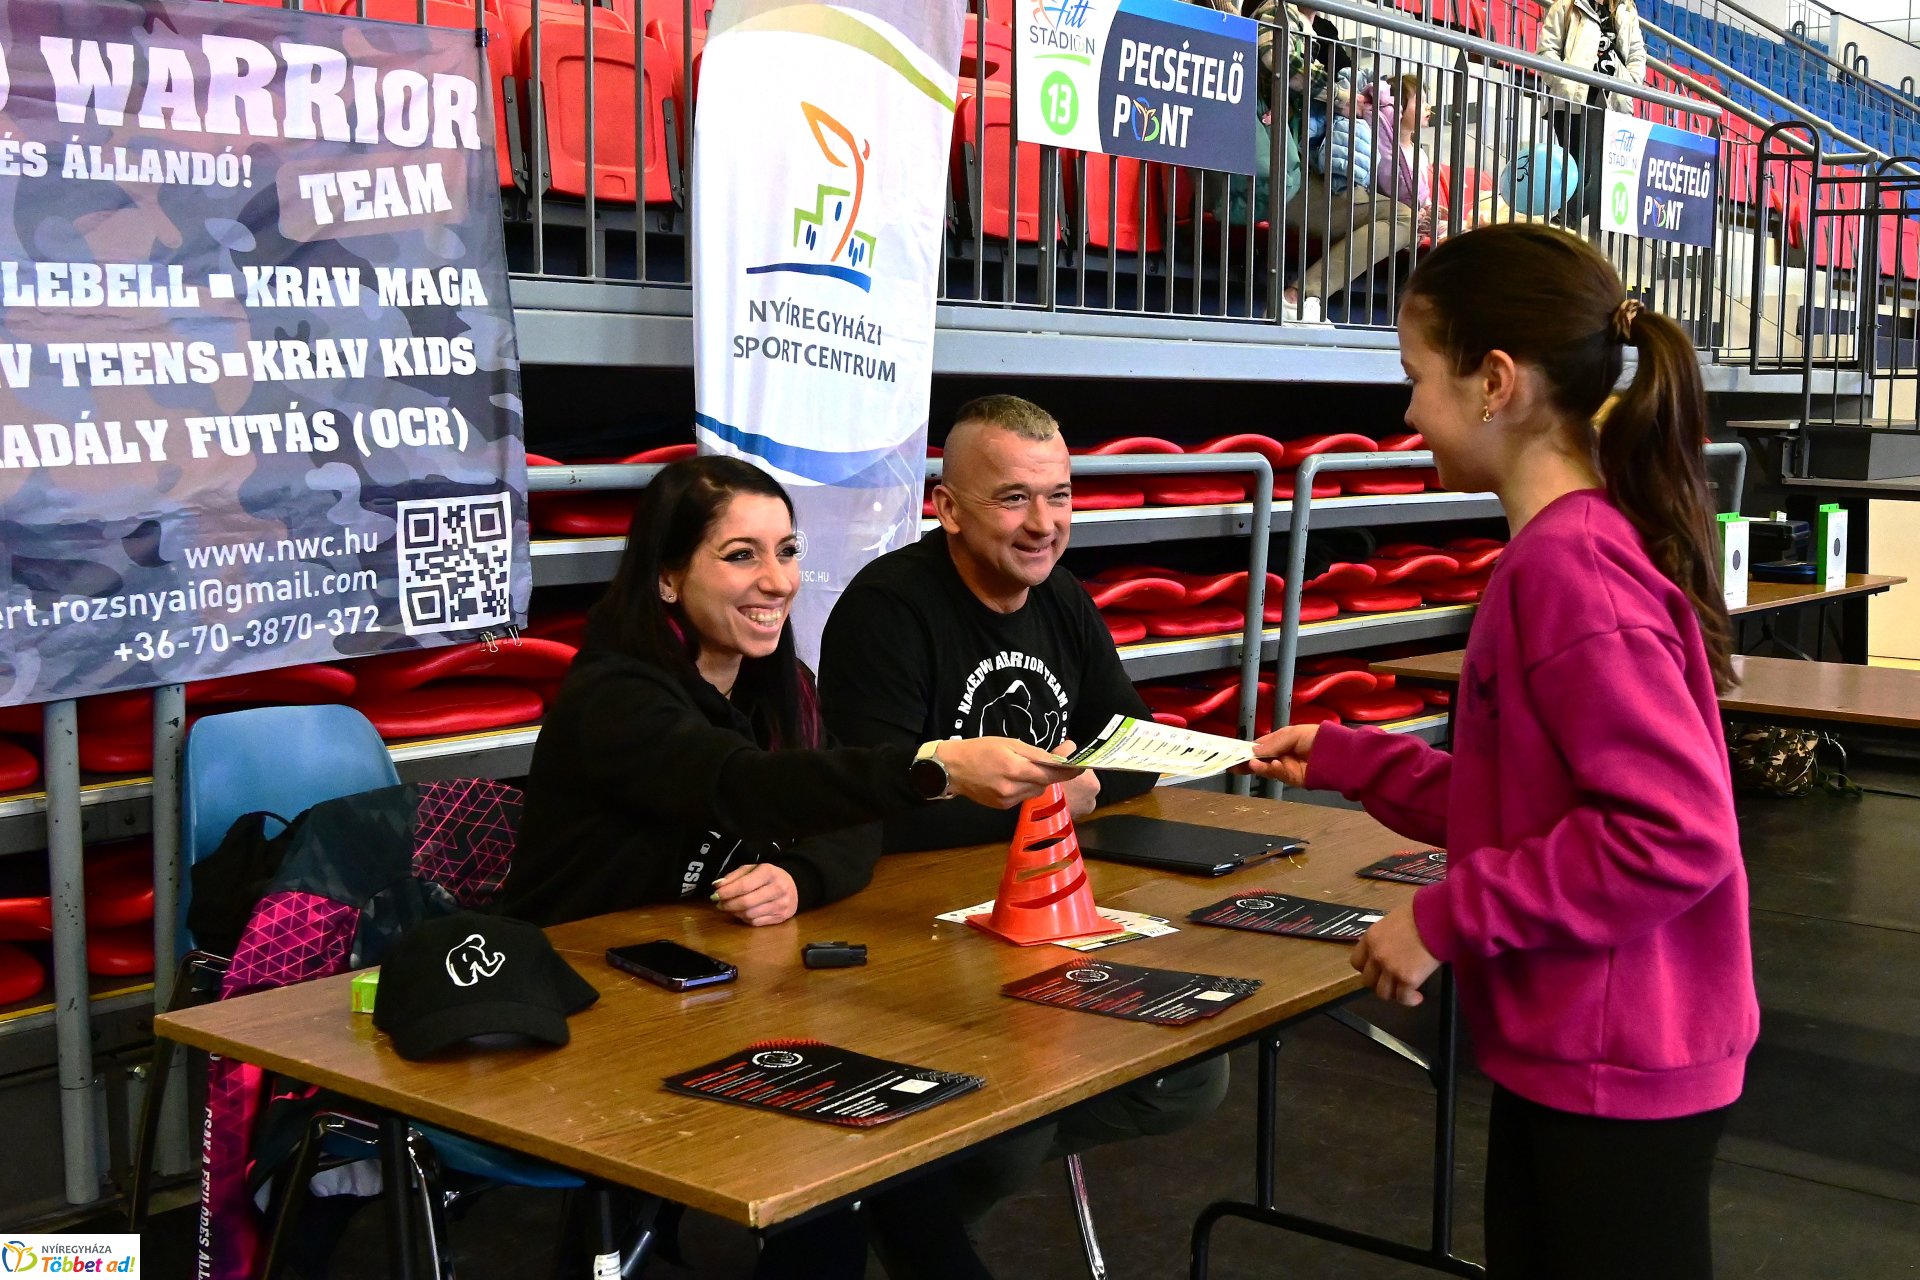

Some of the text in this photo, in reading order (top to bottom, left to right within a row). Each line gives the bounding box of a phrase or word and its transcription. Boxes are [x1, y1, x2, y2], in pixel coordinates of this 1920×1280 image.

[40, 34, 481, 150] WARRIOR
[1118, 38, 1244, 104] PECSÉTELŐ
[1047, 83, 1072, 125] 13
[62, 135, 252, 188] ÁLLANDÓ!
[1646, 155, 1711, 199] PECSÉTELŐ
[299, 162, 453, 225] TEAM
[1614, 190, 1627, 218] 14
[1, 261, 488, 307] LEBELL KRAV MAGA
[749, 297, 882, 346] NYÍREGYHÁZI
[0, 336, 477, 389] V TEENS KRAV KIDS
[733, 334, 896, 383] SPORTCENTRUM
[0, 401, 470, 469] ADÁLY FUTÁS (OCR)
[184, 527, 379, 570] www.nwc.hu
[0, 569, 378, 630] rt.rozsnyai@gmail.com
[799, 570, 829, 583] ISC.HU
[113, 605, 382, 663] +36-70-3870-372
